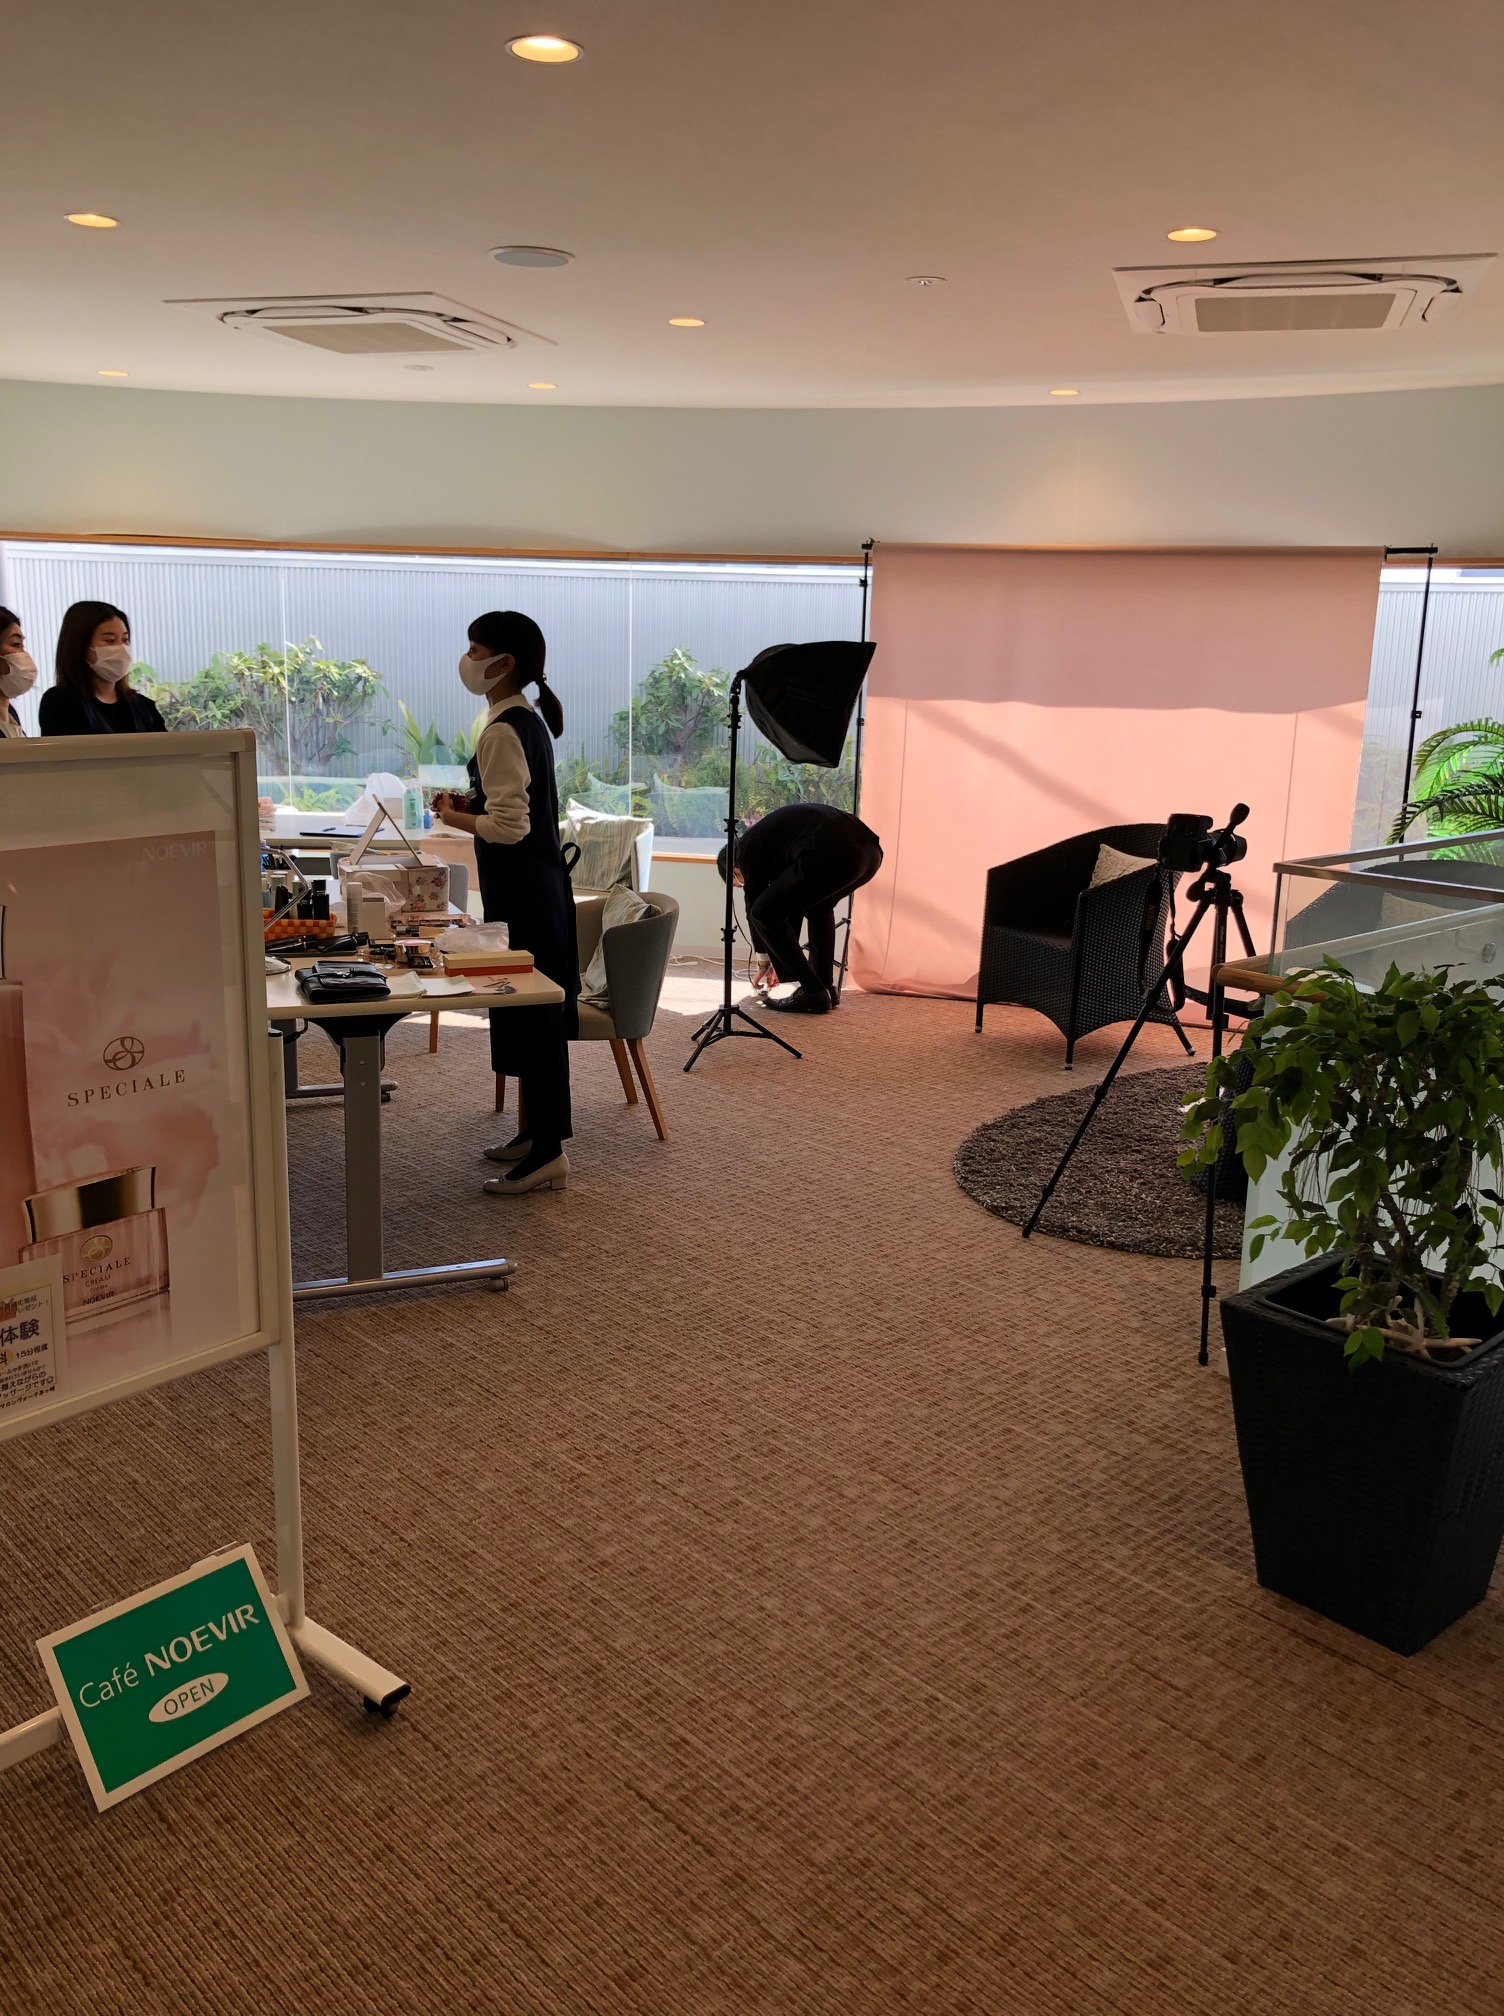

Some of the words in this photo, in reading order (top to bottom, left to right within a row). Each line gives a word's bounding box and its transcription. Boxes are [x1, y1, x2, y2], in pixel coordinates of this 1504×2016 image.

[142, 841, 208, 864] NOEVIR
[67, 1069, 185, 1107] SPECIALE
[62, 1256, 131, 1284] SPECIALE
[84, 1274, 112, 1287] CREAM
[82, 1291, 114, 1306] NOEVIR
[79, 1661, 139, 1708] Café
[143, 1603, 260, 1677] NOEVIR
[163, 1678, 215, 1715] OPEN
